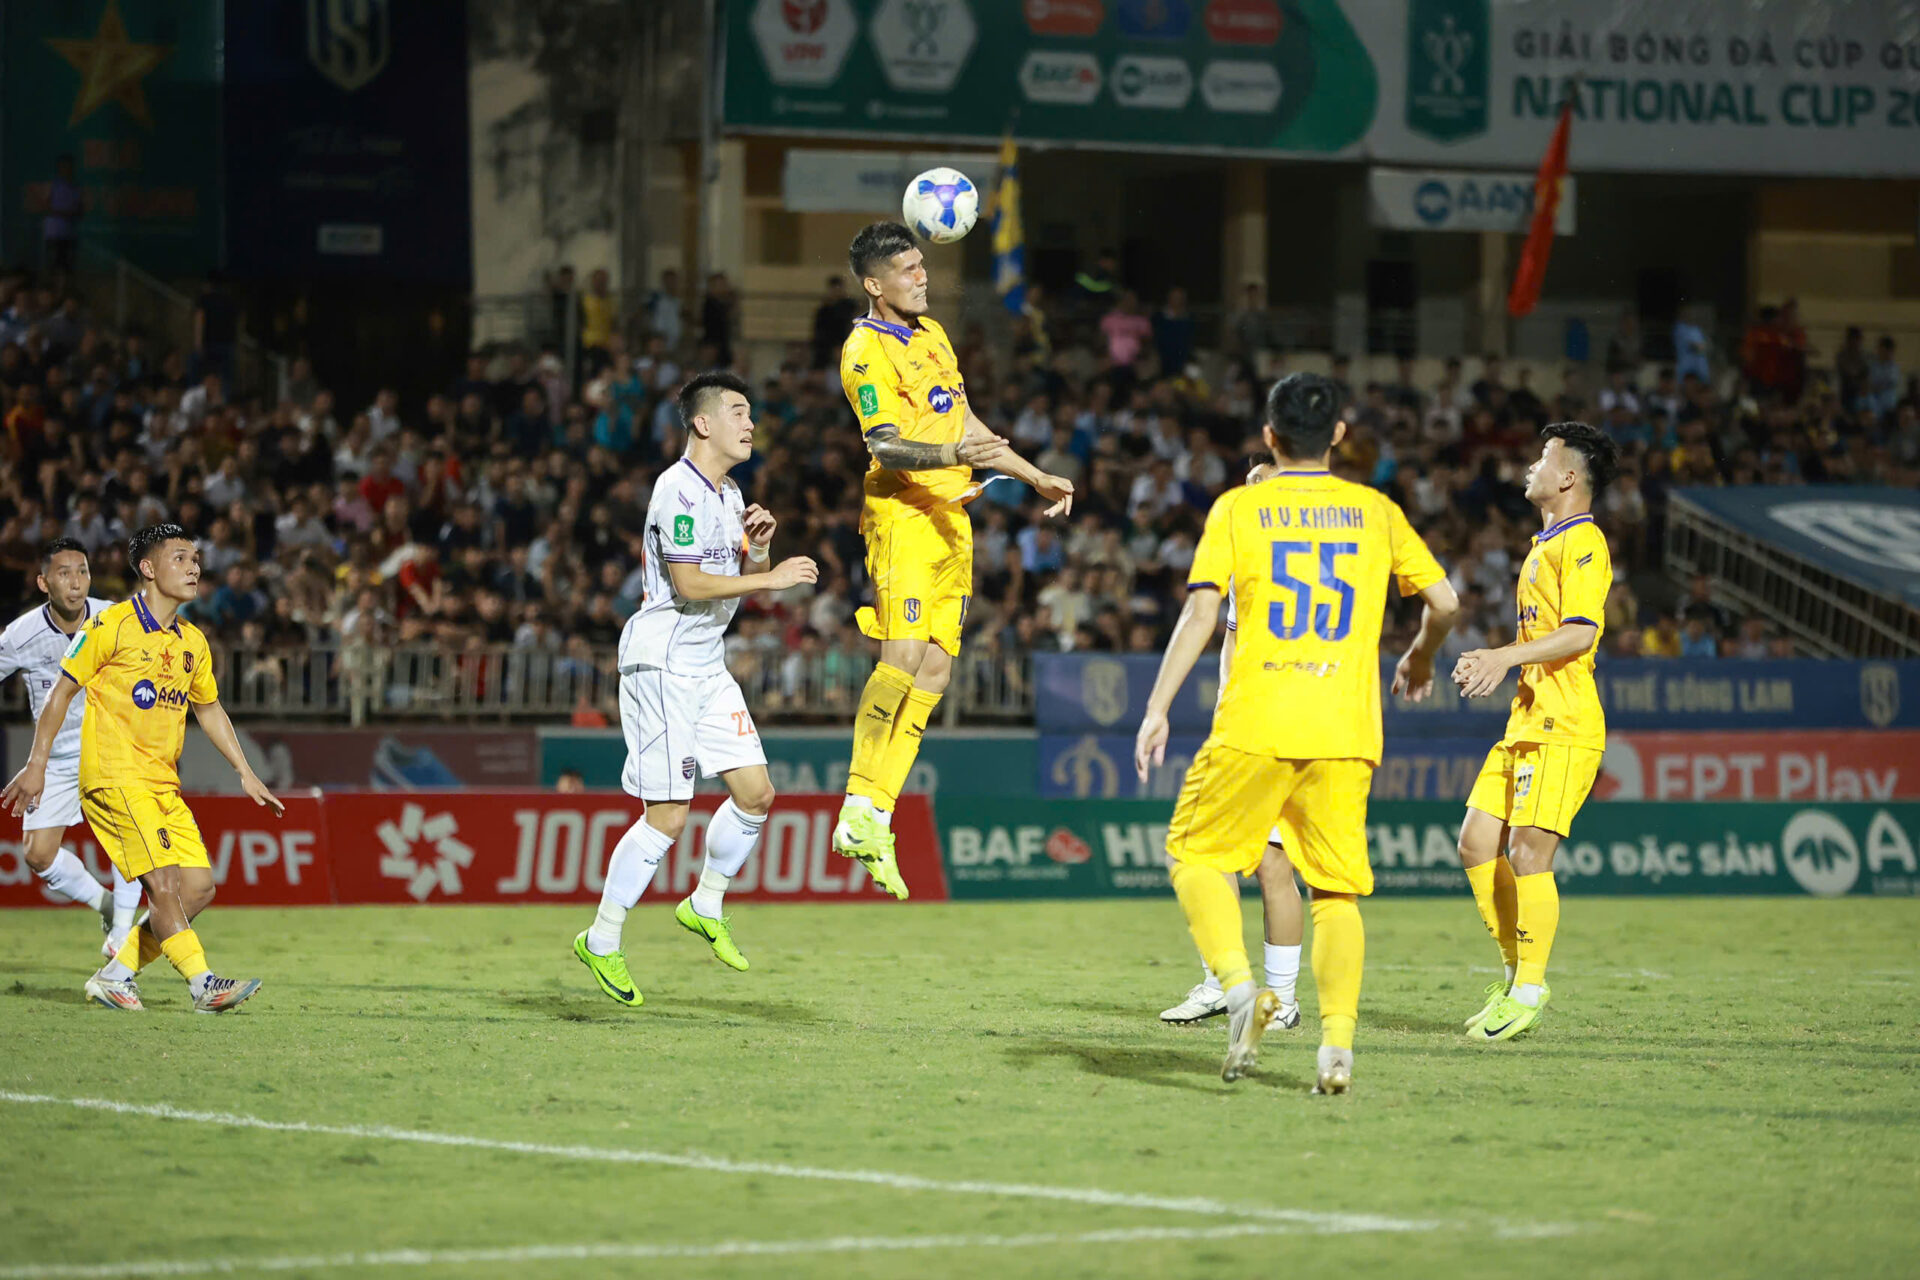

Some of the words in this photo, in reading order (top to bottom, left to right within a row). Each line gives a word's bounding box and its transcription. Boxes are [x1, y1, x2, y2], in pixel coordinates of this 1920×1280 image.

[1608, 30, 1711, 66] BÓNG
[1729, 31, 1777, 66] ĐÁ
[1793, 33, 1865, 69] CÚP
[1512, 74, 1768, 126] NATIONAL
[1780, 84, 1877, 128] CUP
[1258, 504, 1364, 529] H.V.KHÁNH
[1268, 540, 1358, 642] 55
[1739, 678, 1794, 713] LAM
[1655, 752, 1766, 801] FPT
[950, 824, 1046, 866] BAF
[1610, 834, 1693, 884] ĐẶC
